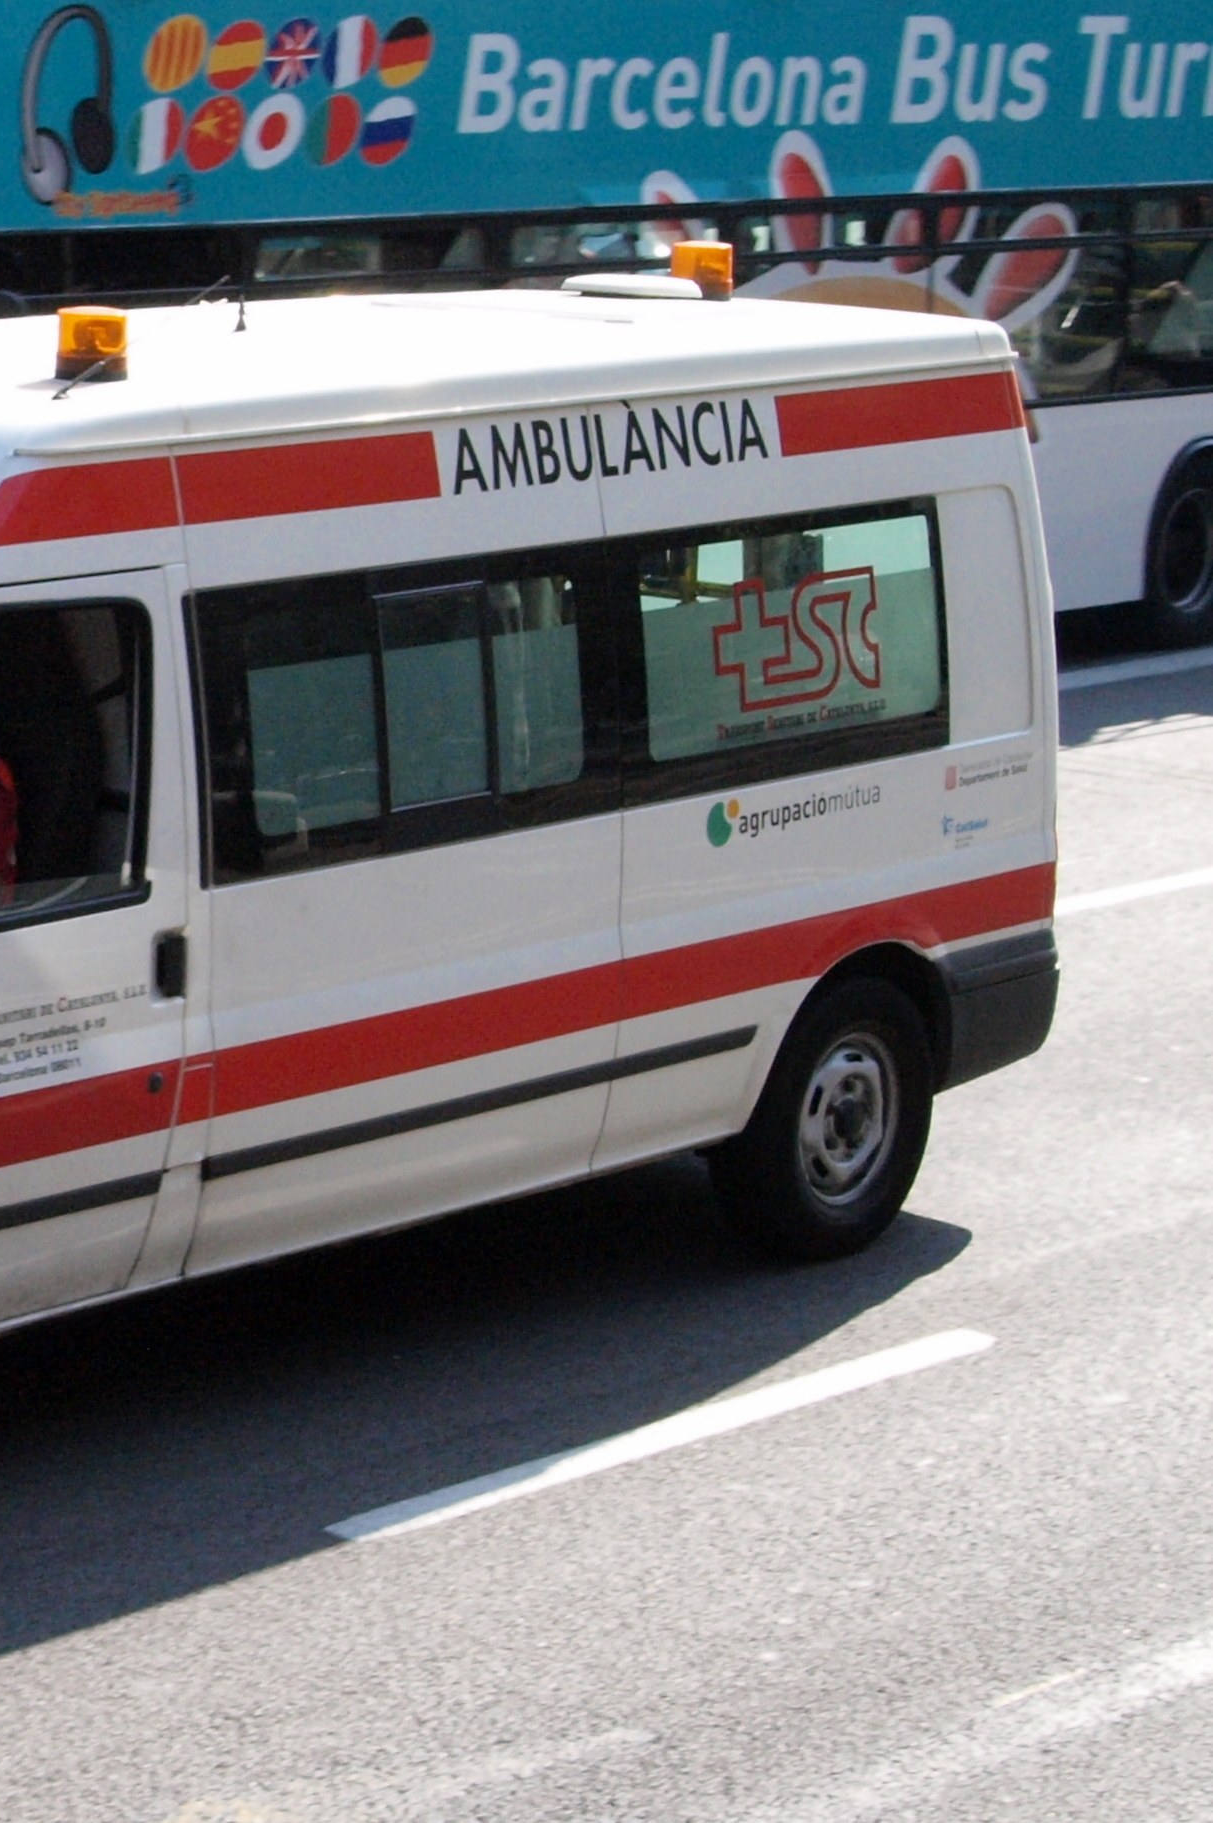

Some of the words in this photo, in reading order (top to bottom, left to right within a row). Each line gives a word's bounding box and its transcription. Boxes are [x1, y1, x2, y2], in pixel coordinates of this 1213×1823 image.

[457, 32, 867, 133] Barcelona
[890, 15, 1052, 123] Bus
[454, 399, 768, 495] AMBULÀNCIA
